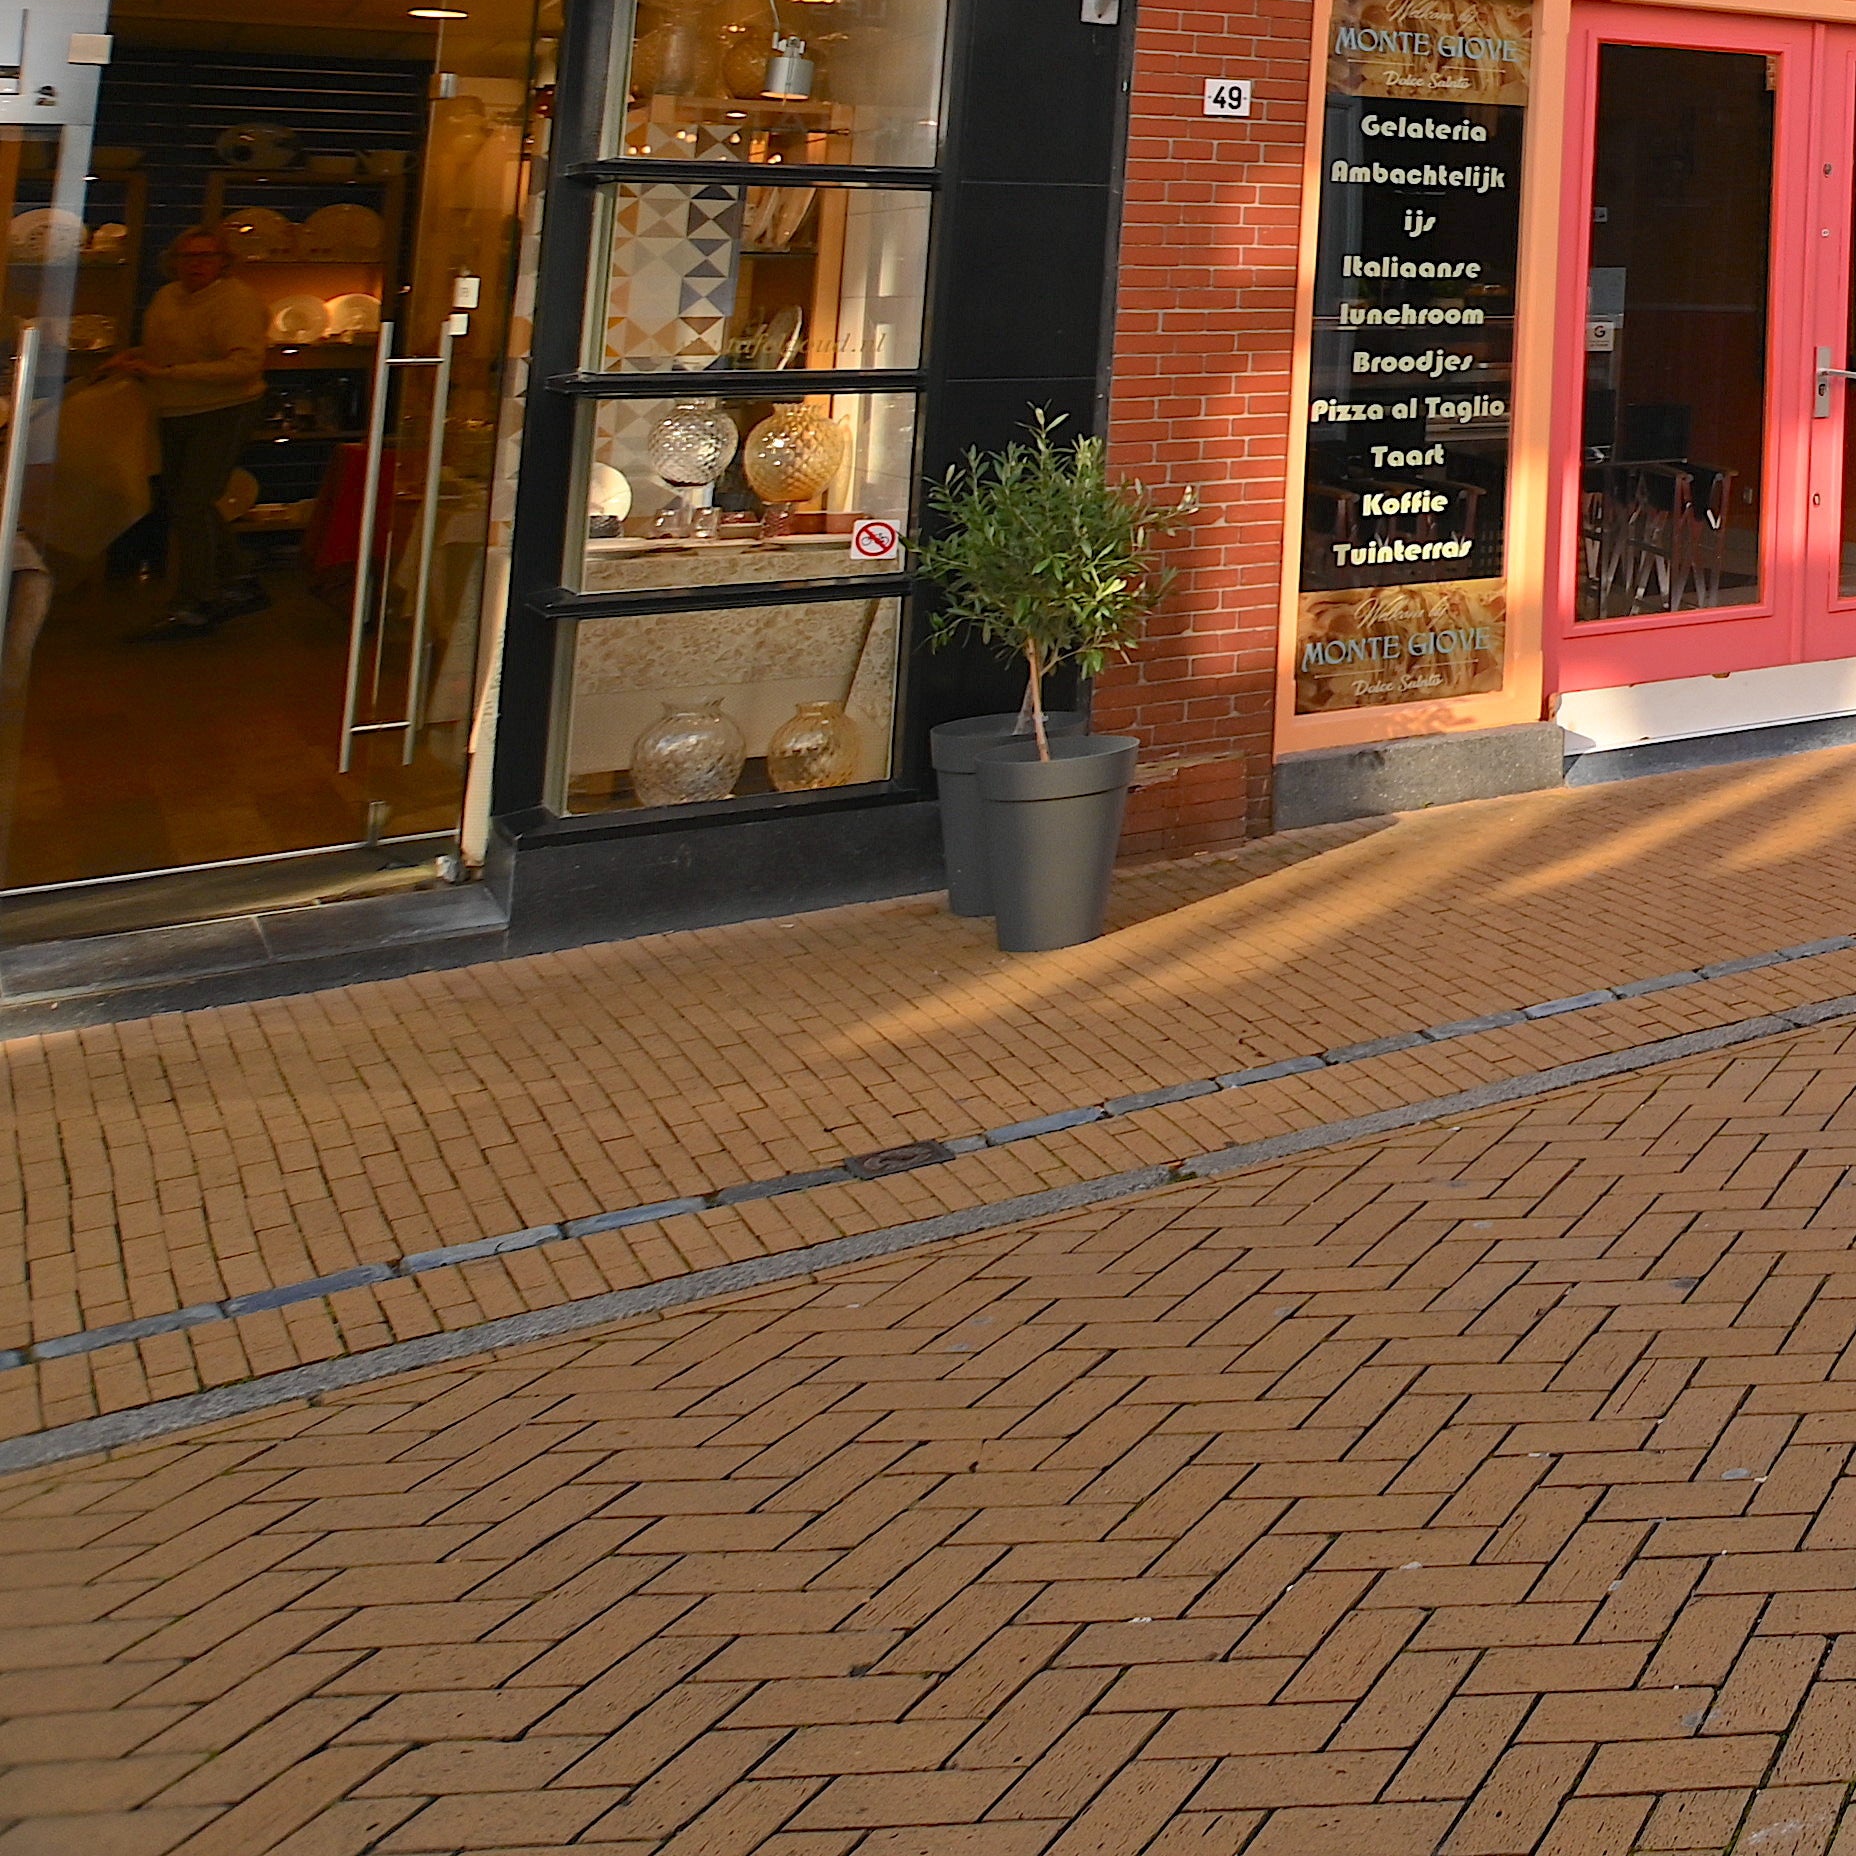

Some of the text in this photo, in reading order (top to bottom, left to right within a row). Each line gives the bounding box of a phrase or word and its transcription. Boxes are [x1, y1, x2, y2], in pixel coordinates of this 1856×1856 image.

[1335, 27, 1521, 63] MONTE GIOVE
[1382, 70, 1425, 88] Dolce
[1211, 86, 1243, 111] 49
[1360, 114, 1488, 142] Gelateria
[1330, 160, 1506, 194] Ambachtelijk
[1404, 208, 1437, 239] ijs
[1342, 255, 1482, 281] Italiaanse
[1339, 303, 1485, 326] lunchroom
[1593, 325, 1606, 338] G
[1352, 349, 1475, 380] Broodjes
[1310, 395, 1506, 425] Pizza al Taglio
[1370, 442, 1446, 468] Taart
[1361, 490, 1449, 518] Koffie
[1332, 539, 1474, 567] Tuinterras
[1302, 626, 1491, 672] MONTE GIOVE
[1352, 678, 1394, 697] Dolce
